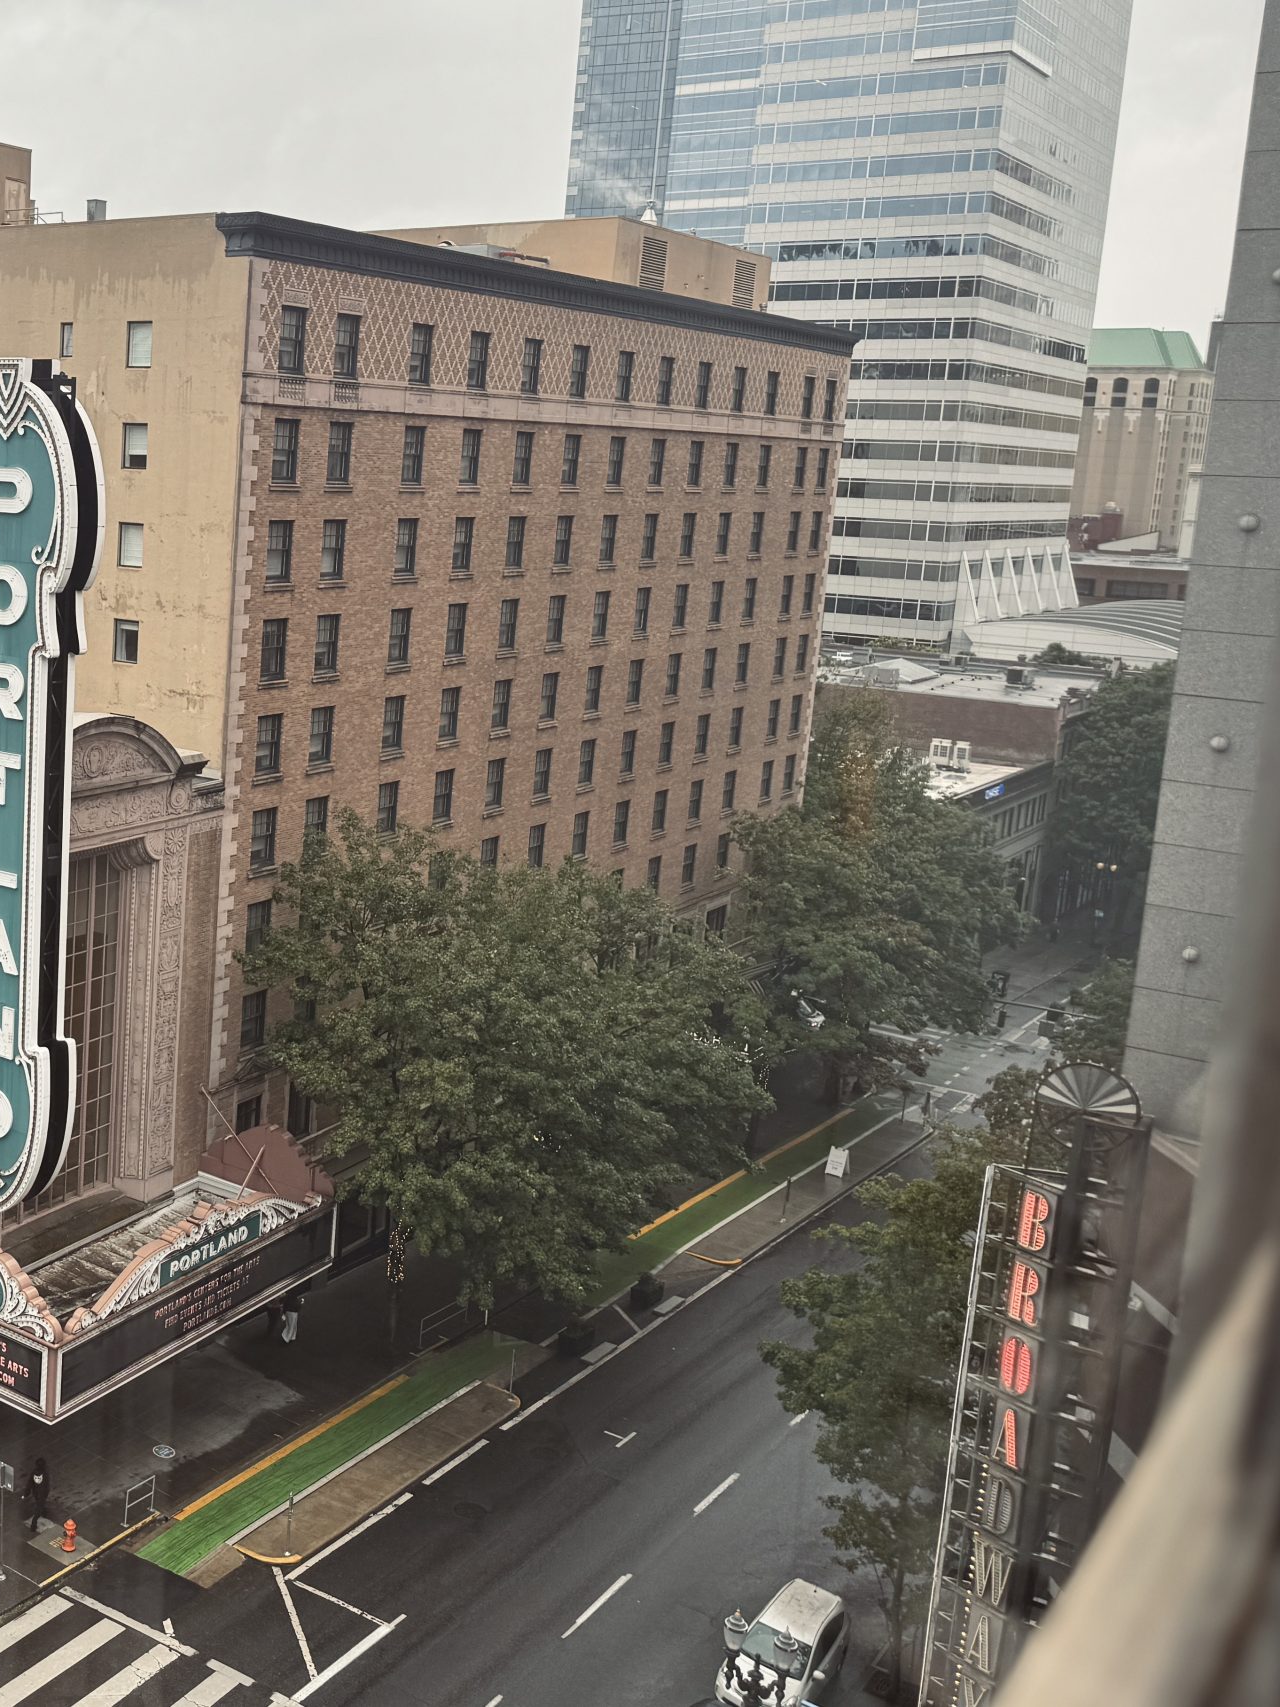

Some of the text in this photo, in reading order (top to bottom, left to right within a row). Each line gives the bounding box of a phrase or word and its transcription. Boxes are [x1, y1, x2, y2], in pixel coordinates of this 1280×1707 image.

[169, 1225, 248, 1278] PORTLAND
[154, 1292, 192, 1319] PORTLAND'S
[193, 1277, 219, 1298] CENTERS
[179, 1300, 202, 1320] EVENTS
[217, 1279, 240, 1299] TICKETS
[7, 1359, 29, 1378] ARTS
